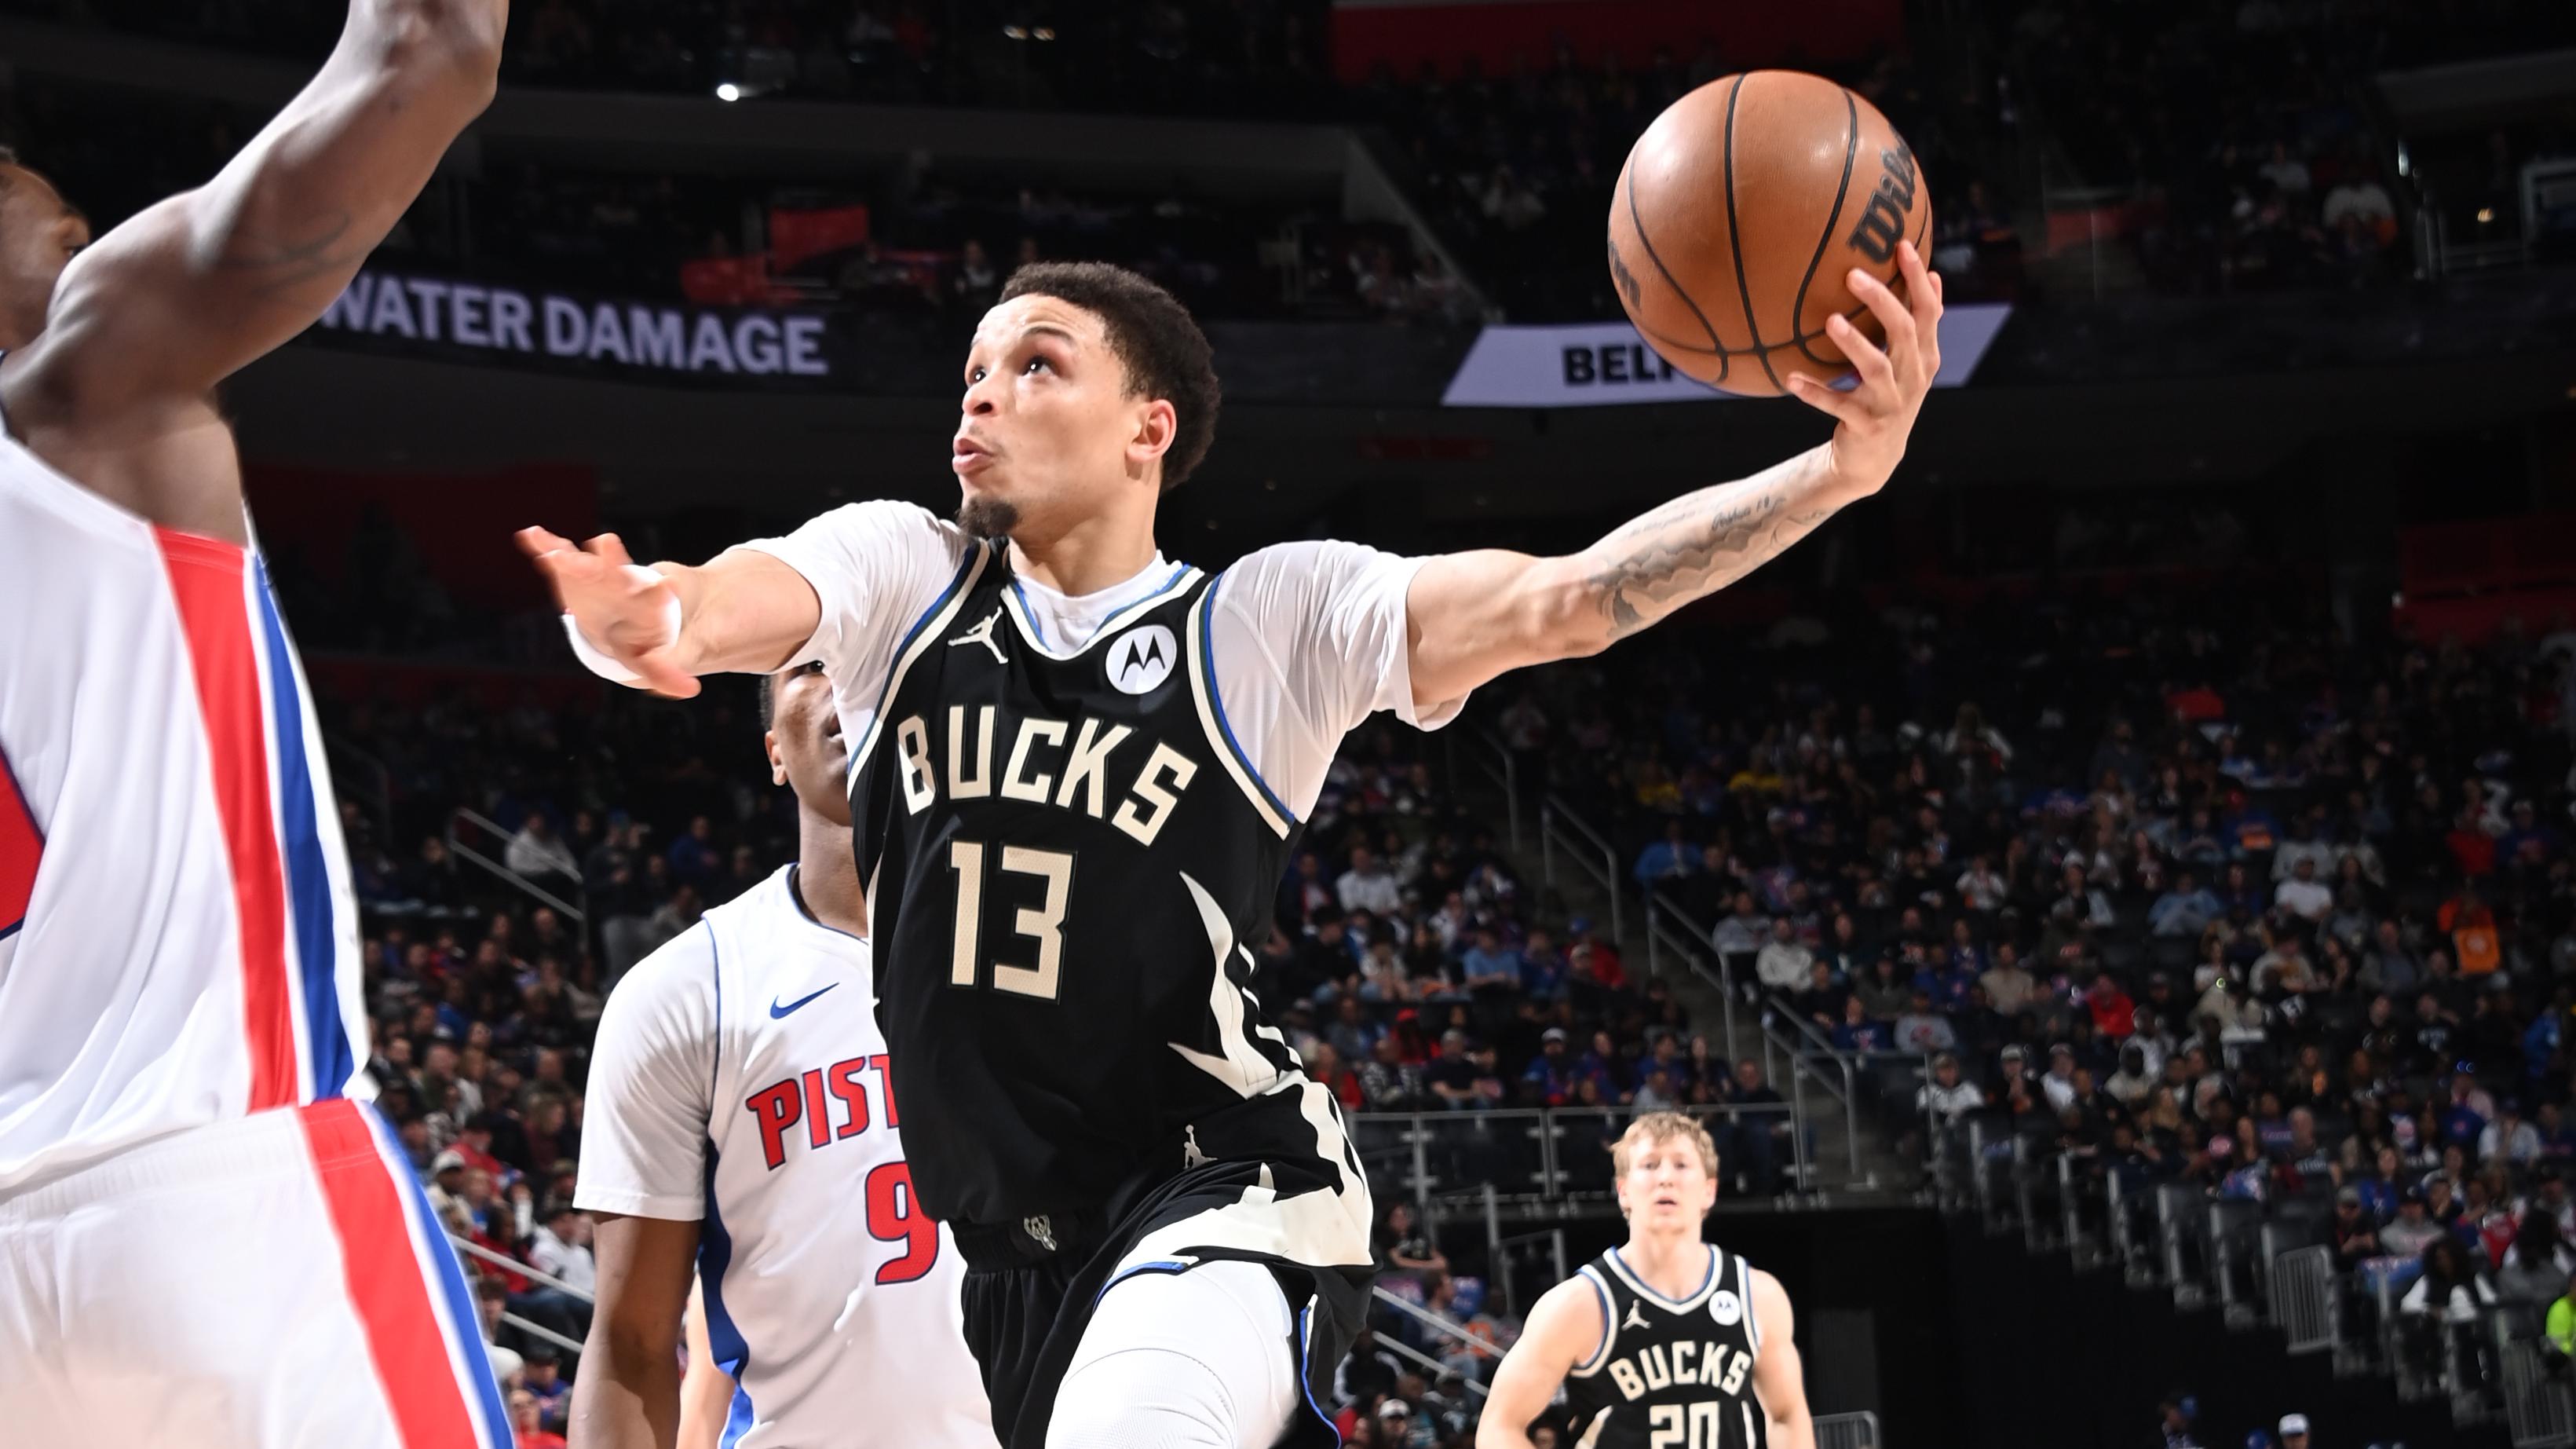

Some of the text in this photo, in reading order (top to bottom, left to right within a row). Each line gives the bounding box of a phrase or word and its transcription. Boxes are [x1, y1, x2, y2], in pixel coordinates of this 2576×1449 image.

[320, 273, 829, 375] WATER DAMAGE
[897, 704, 1199, 847] BUCKS
[948, 840, 1076, 1001] 13
[864, 1161, 940, 1286] 9
[1608, 1340, 1752, 1402] BUCKS
[1650, 1401, 1721, 1449] 20
